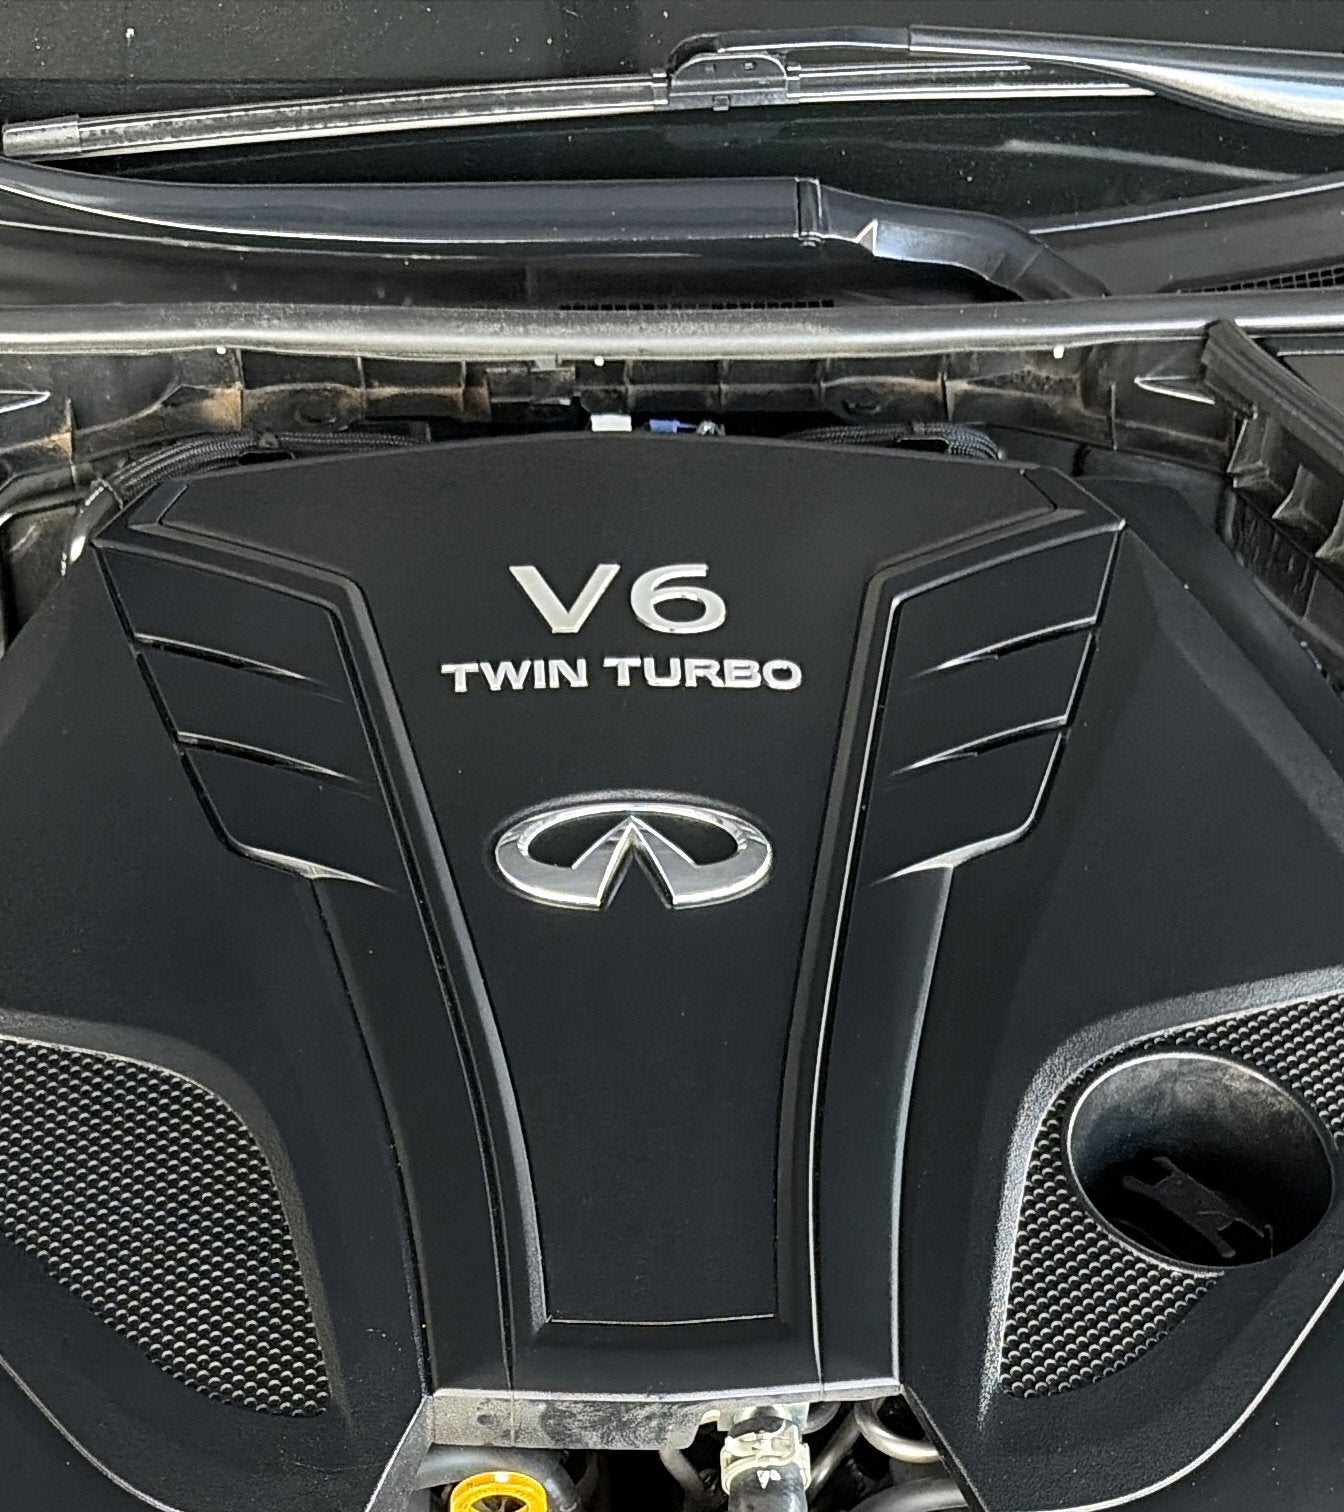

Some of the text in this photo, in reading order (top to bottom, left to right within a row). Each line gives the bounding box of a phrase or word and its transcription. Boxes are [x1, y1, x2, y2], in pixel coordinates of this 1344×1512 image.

[509, 563, 727, 634] V6
[441, 656, 803, 692] TWIN TURBO
